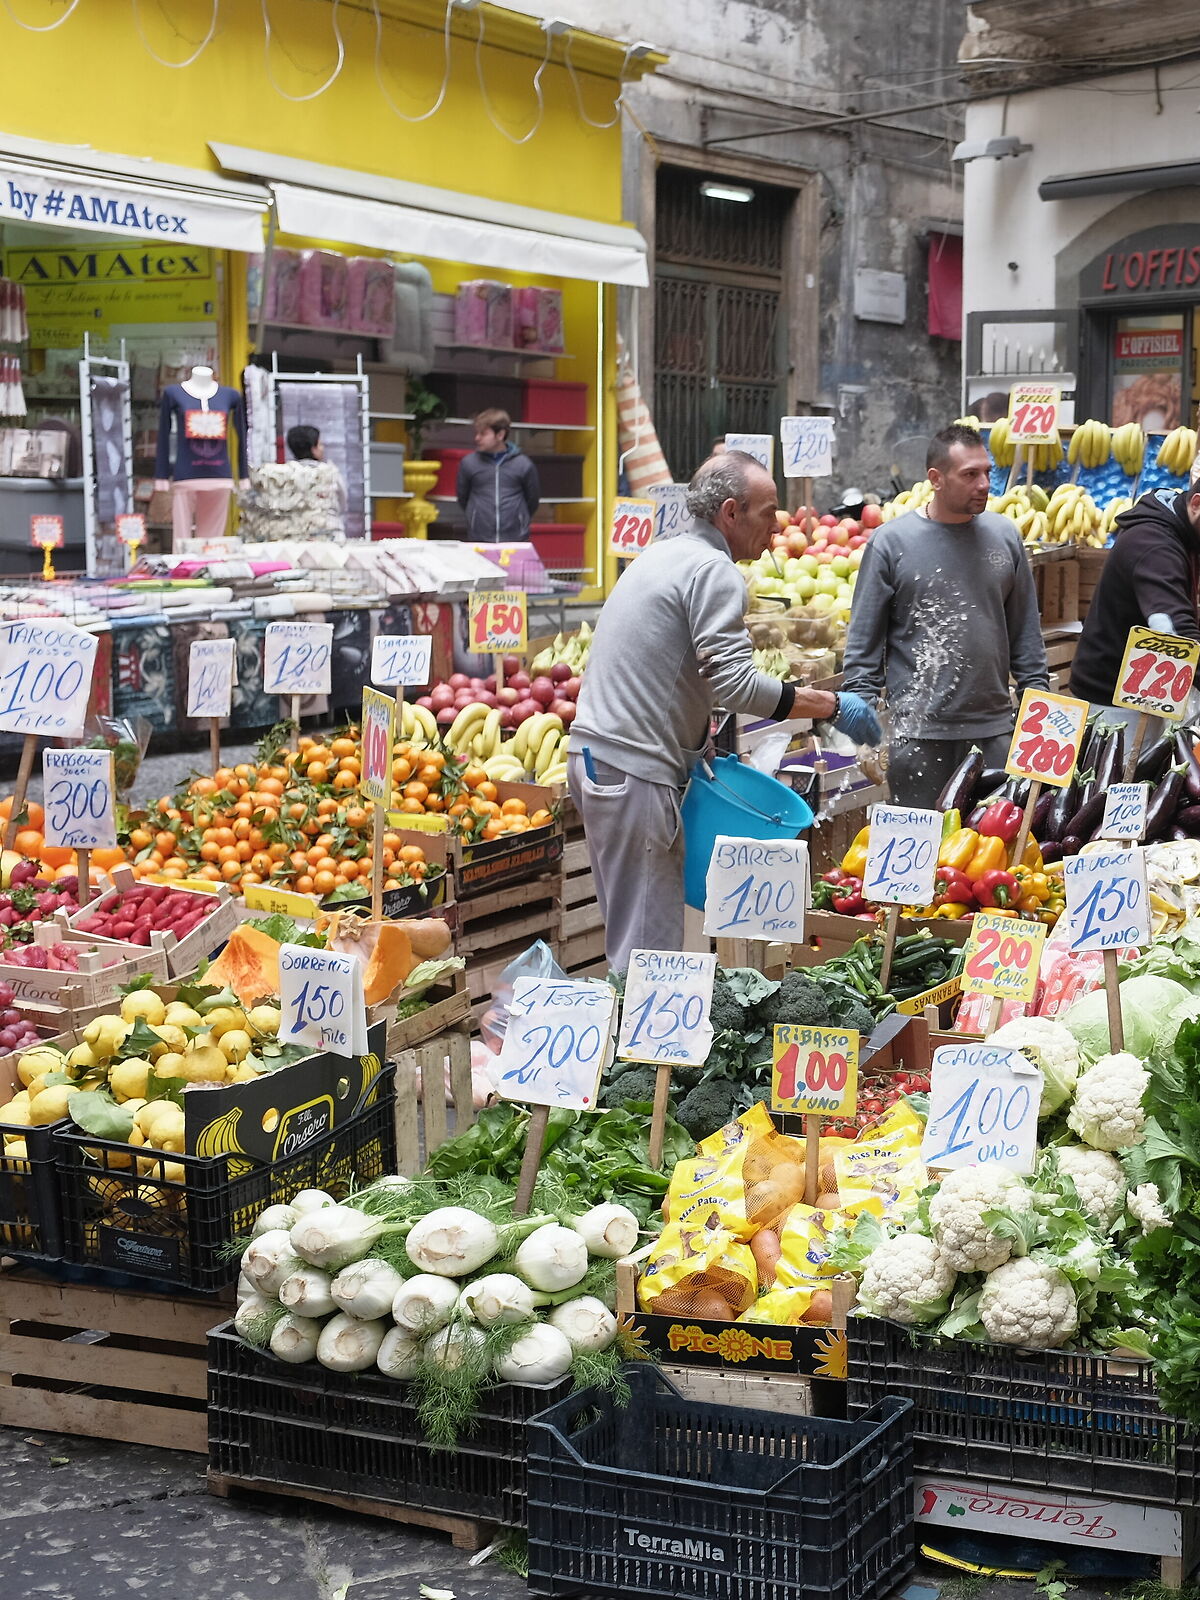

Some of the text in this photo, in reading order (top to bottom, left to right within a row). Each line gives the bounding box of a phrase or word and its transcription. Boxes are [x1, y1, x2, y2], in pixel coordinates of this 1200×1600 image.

[8, 181, 188, 234] by #AMAtex
[19, 253, 201, 280] AMAtex
[1120, 334, 1179, 355] L'OFFISIEL
[2, 623, 93, 650] TAROCCO
[381, 651, 426, 682] 120
[1021, 702, 1049, 734] 2
[50, 779, 108, 831] 300
[1106, 803, 1141, 830] 100
[1119, 824, 1141, 833] UNO
[716, 844, 800, 869] BARESI
[869, 837, 932, 887] 130
[1072, 876, 1140, 949] 150
[1101, 926, 1139, 946] UNO
[291, 981, 344, 1034] 150
[624, 990, 704, 1048] 150
[320, 1027, 347, 1045] KILO
[283, 1112, 328, 1157] Orsero
[848, 1152, 870, 1162] Miss
[977, 1139, 1019, 1162] UNO
[669, 1328, 794, 1361] PICONE
[969, 1497, 1117, 1540] Ferrera
[623, 1527, 725, 1561] TerraMia
